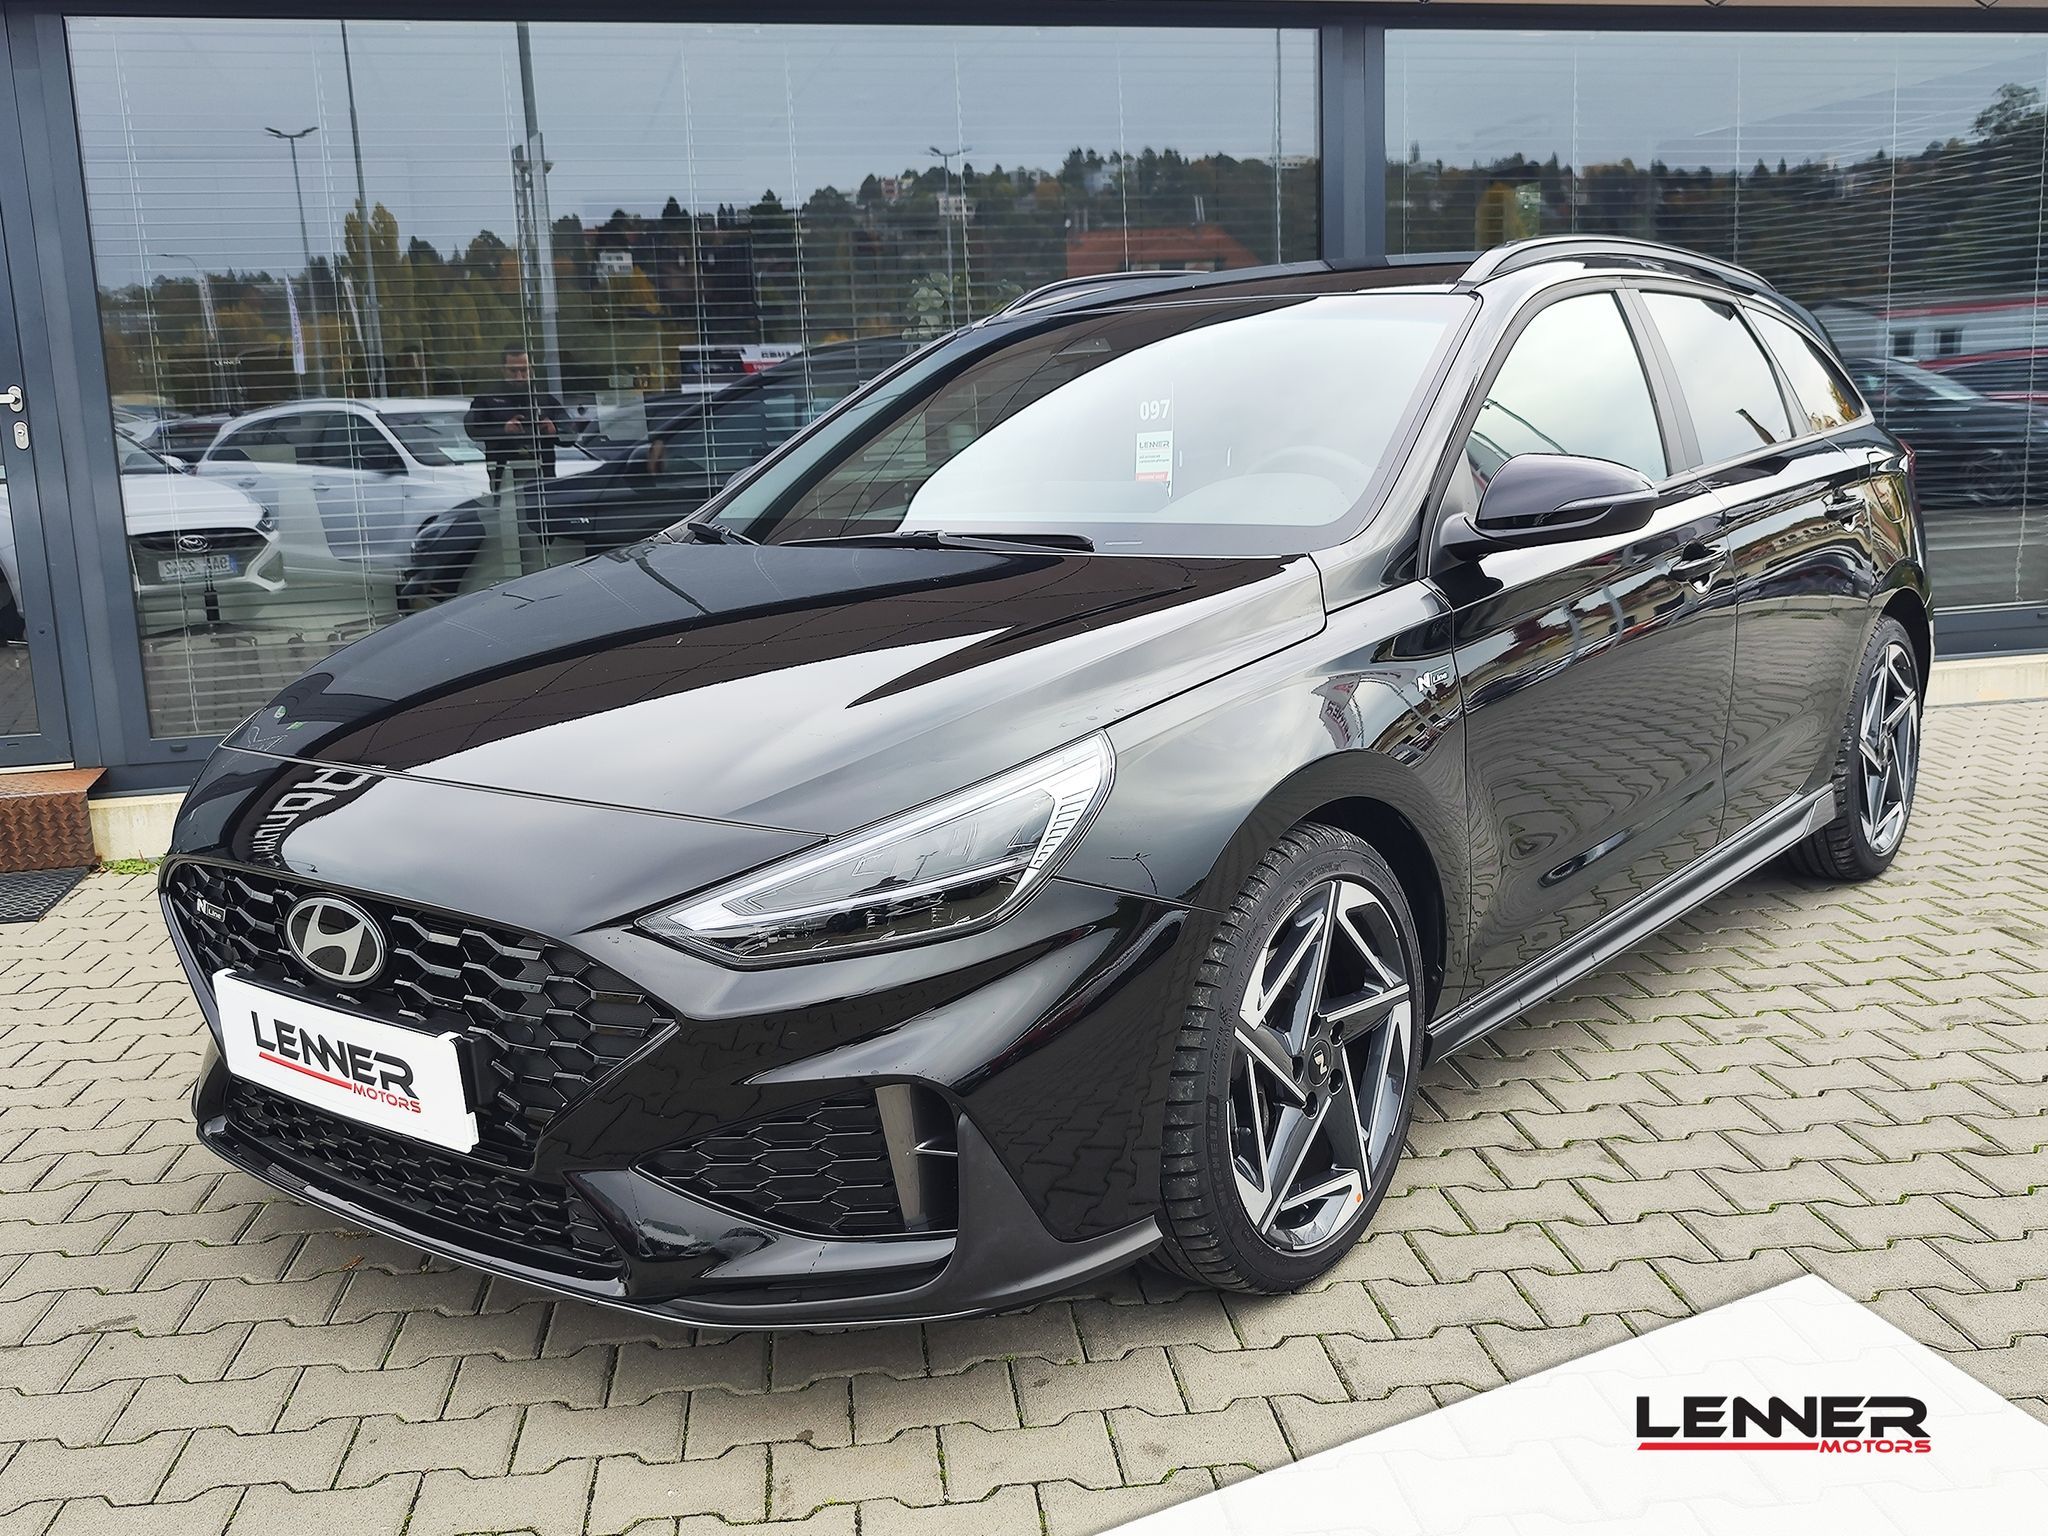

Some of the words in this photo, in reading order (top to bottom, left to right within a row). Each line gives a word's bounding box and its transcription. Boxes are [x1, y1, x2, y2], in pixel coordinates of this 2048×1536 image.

[1139, 399, 1170, 421] 097
[1417, 672, 1430, 692] N
[196, 898, 206, 915] N
[251, 1010, 420, 1100] LENNER
[353, 1082, 422, 1114] MOTORS
